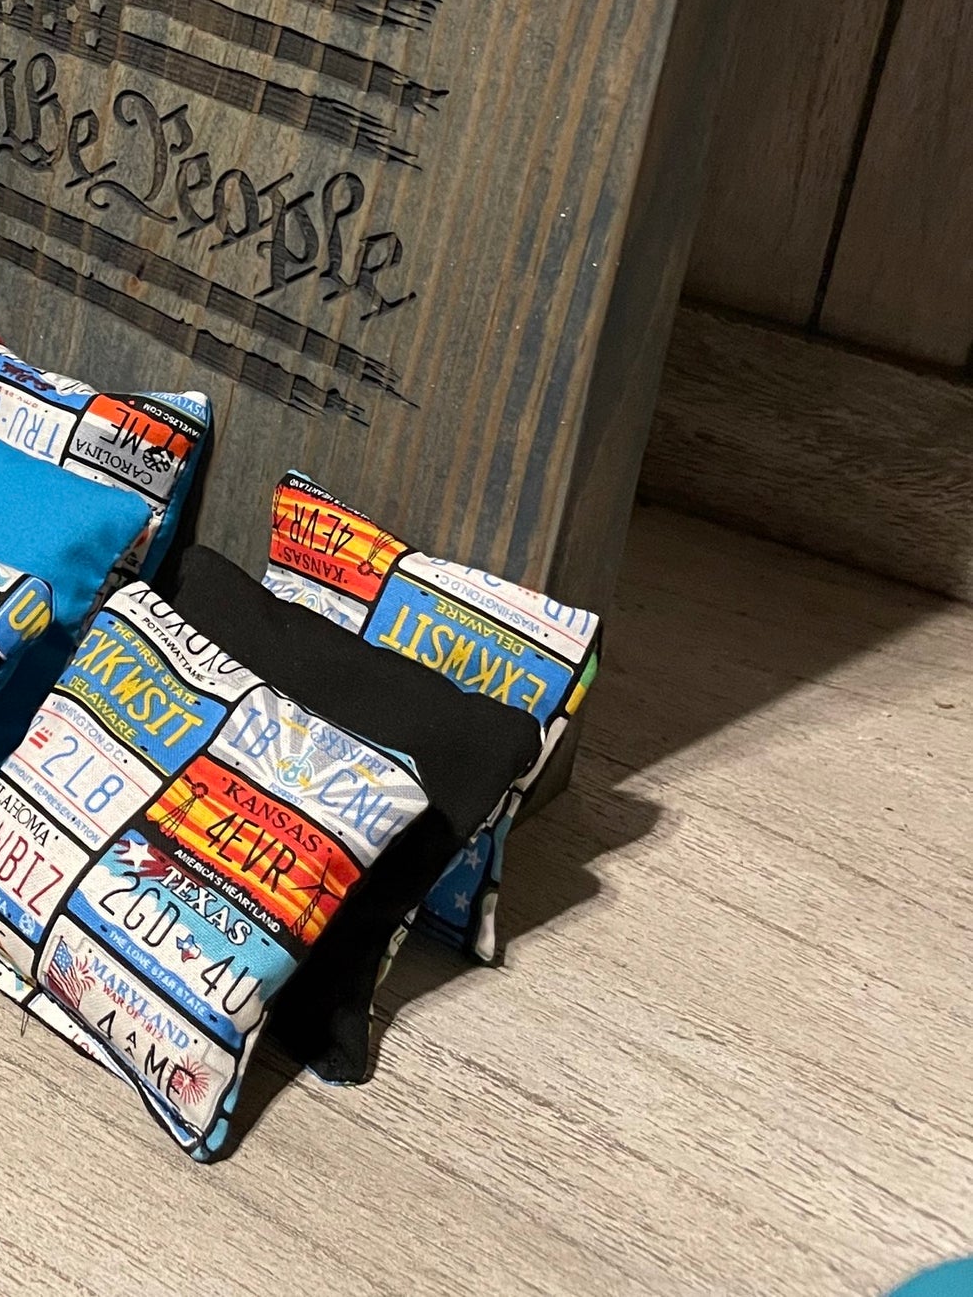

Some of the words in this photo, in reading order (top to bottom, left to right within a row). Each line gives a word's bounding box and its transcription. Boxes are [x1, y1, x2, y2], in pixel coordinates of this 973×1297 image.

[85, 91, 416, 320] People
[99, 406, 150, 456] ME
[141, 402, 201, 438] AVEL2SC.COM
[75, 438, 153, 486] CAROLINA
[284, 547, 346, 582] KANSAS
[293, 503, 354, 557] 4EVR
[111, 622, 133, 642] THE
[131, 640, 164, 673] FIRST
[161, 673, 198, 706] STATE
[435, 600, 525, 656] DELAWARE
[69, 675, 138, 741] DELAWARE
[222, 780, 324, 854] KANSAS
[317, 768, 403, 847] CNU
[173, 848, 222, 888] AMERICA'S
[221, 877, 282, 934] HEARTLAND
[205, 812, 297, 894] 4EVR
[159, 862, 253, 946] TEXAS
[98, 871, 182, 948] 2GD
[200, 955, 264, 1016] 4U
[109, 930, 128, 950] THE
[125, 944, 154, 971] LONE
[175, 986, 207, 1017] STATE
[88, 957, 190, 1050] MARYLAND
[102, 983, 125, 1007] WAR
[126, 1003, 142, 1021] OF
[140, 1018, 165, 1043] 1812
